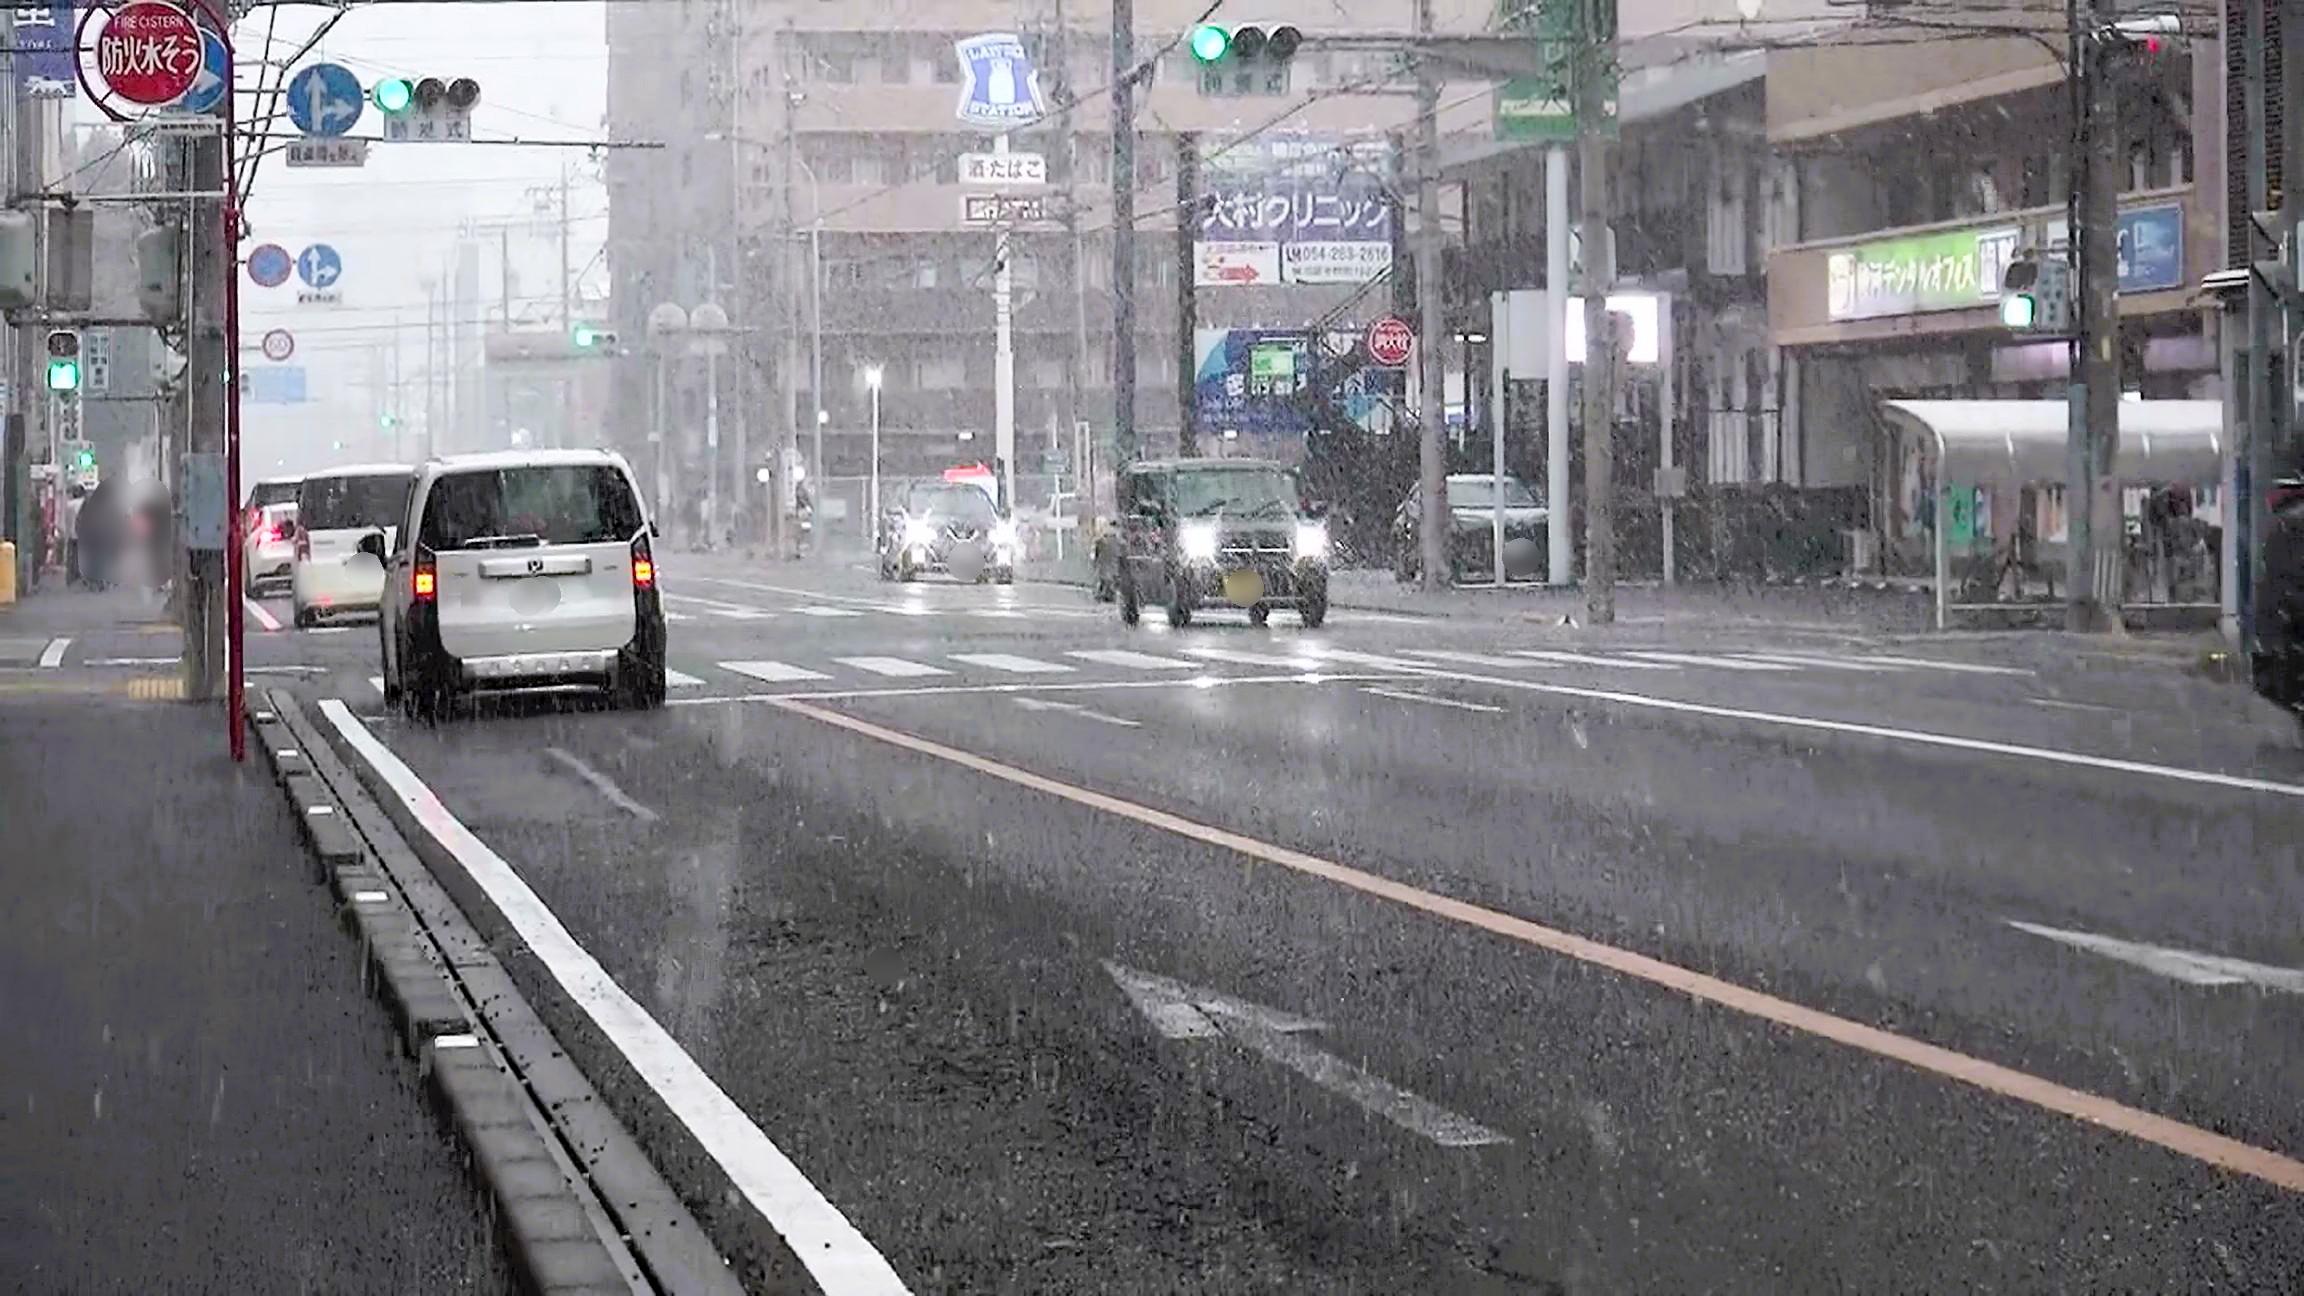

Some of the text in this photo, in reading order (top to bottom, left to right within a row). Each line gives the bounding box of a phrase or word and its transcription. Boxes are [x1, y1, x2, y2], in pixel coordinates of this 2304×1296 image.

[114, 14, 184, 29] FIRE CISTERN
[101, 36, 200, 76] 防火水そう
[967, 44, 1027, 60] LAWSO
[1202, 192, 1389, 229] 大村クリニック
